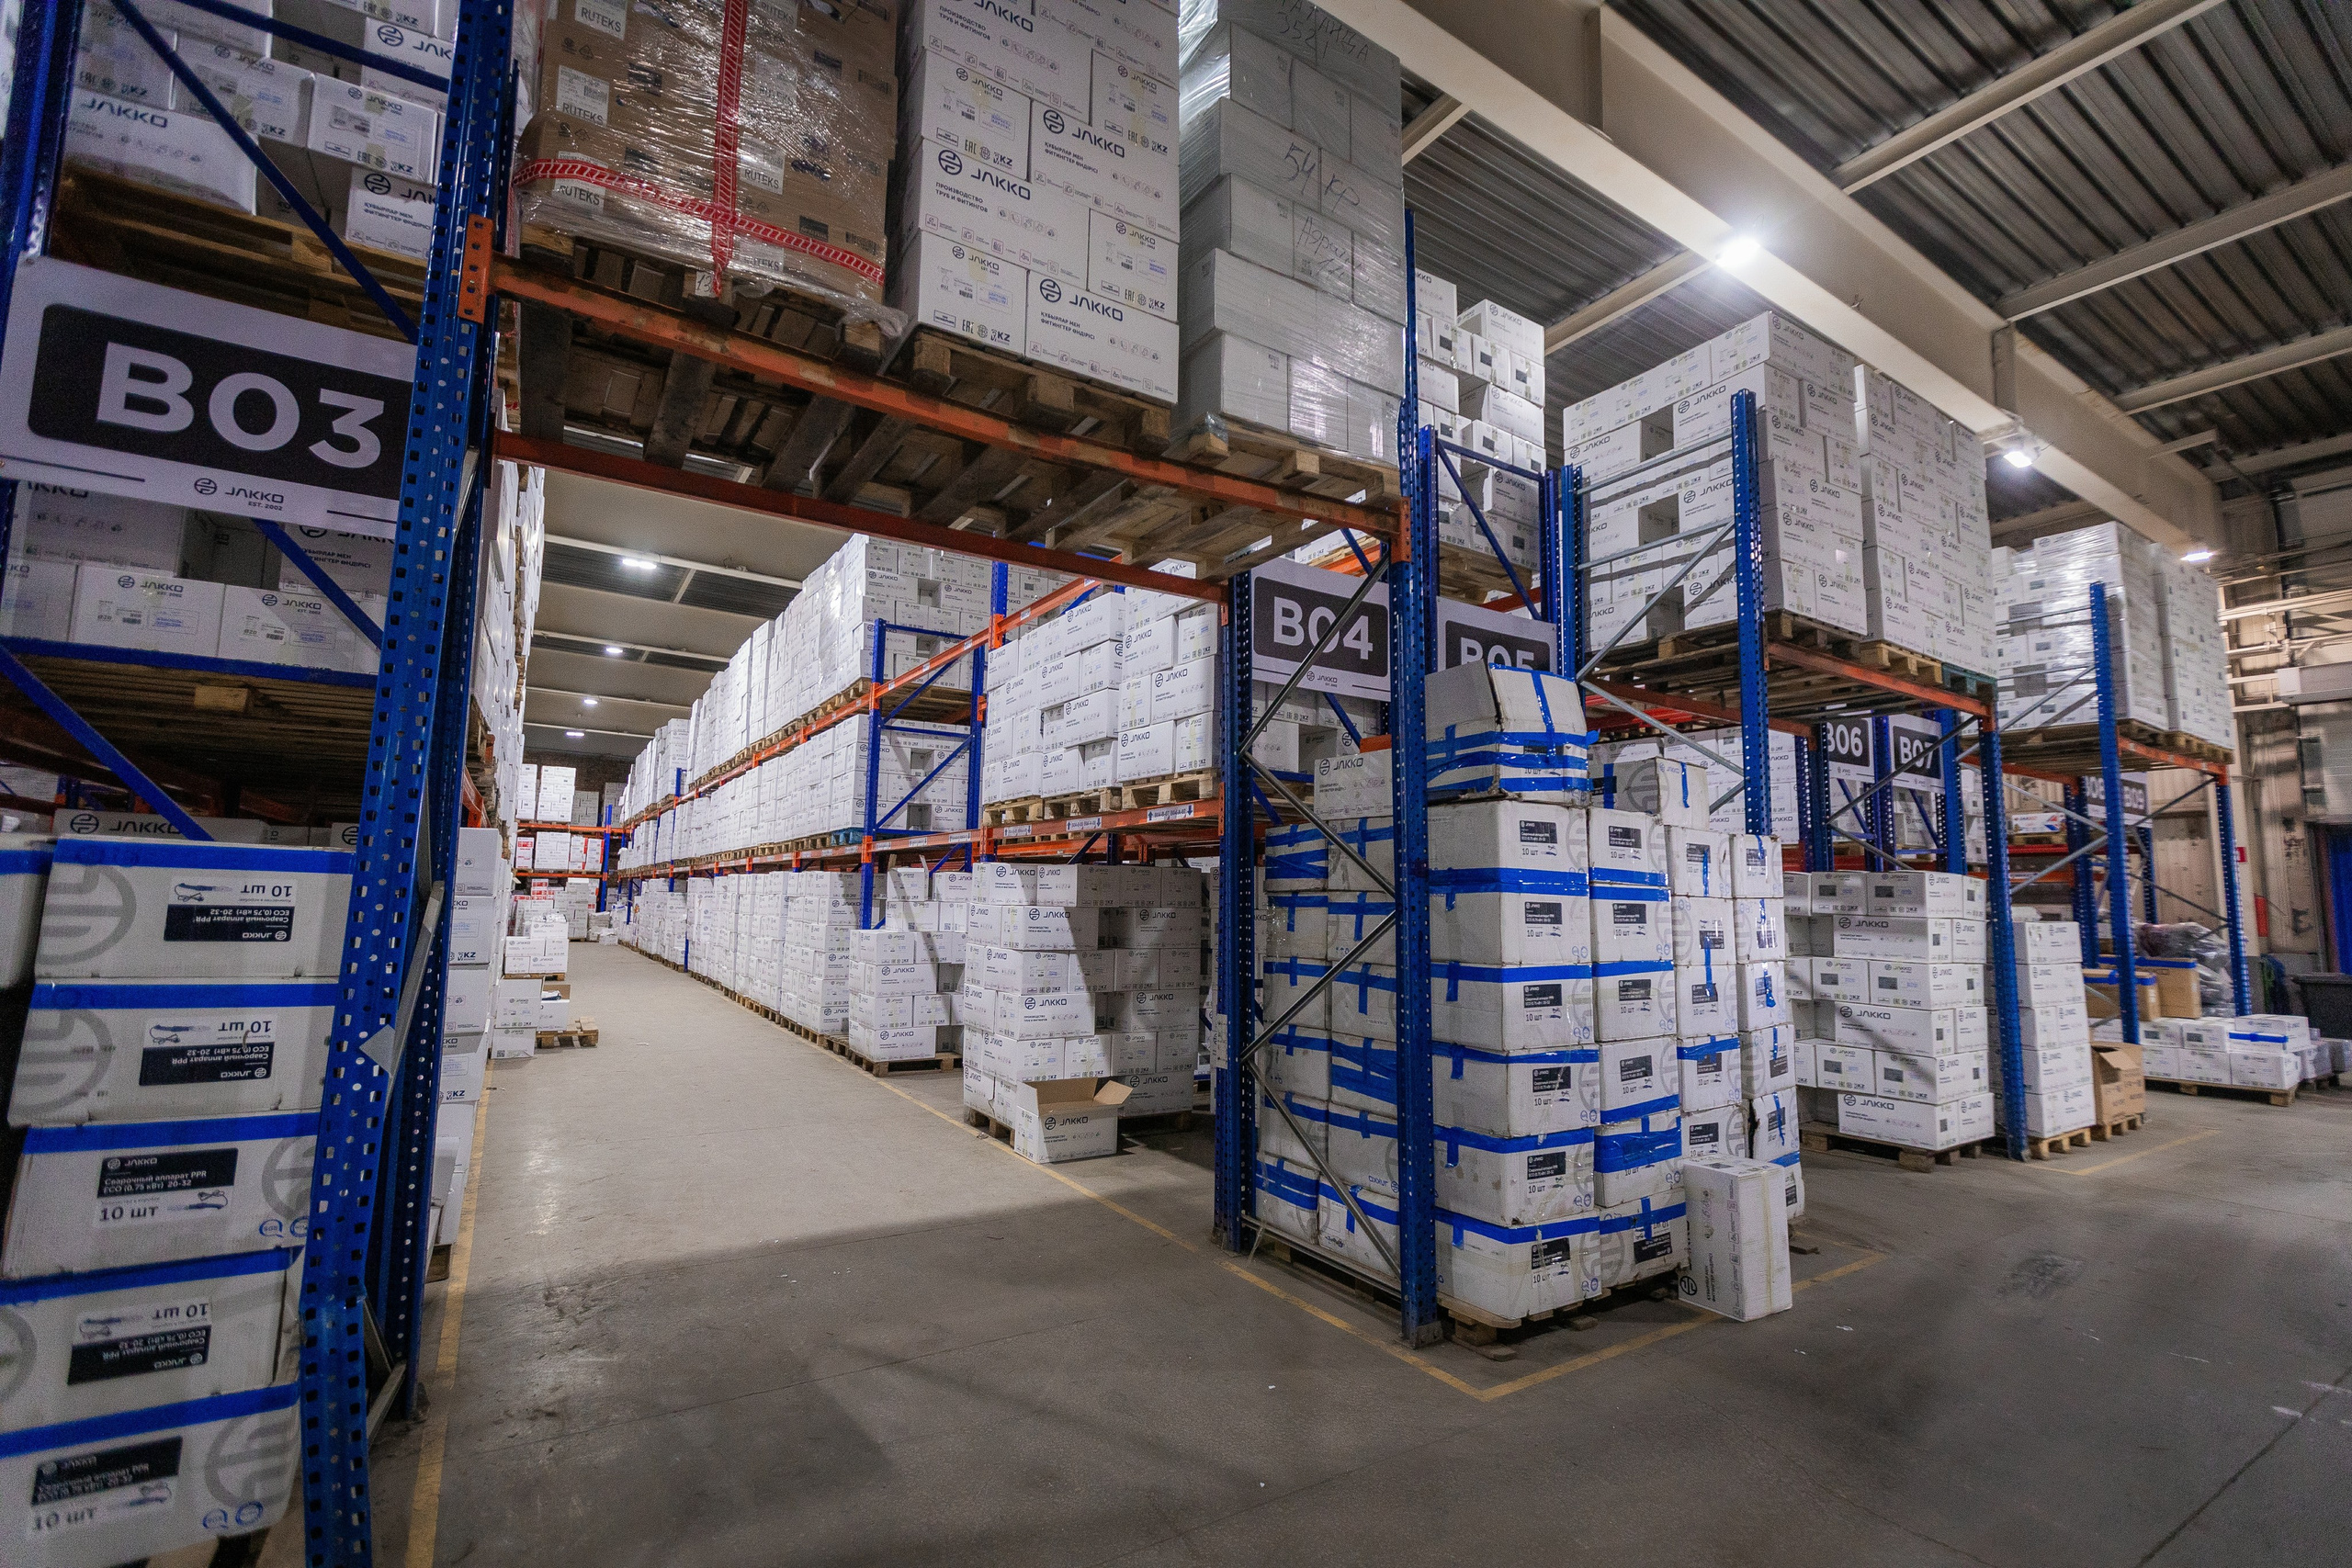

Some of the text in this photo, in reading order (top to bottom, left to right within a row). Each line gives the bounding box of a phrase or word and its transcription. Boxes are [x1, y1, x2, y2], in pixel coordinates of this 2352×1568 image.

[582, 7, 621, 32] RUTEKS
[761, 2, 794, 24] RUTEKS
[939, 6, 986, 30] ПРОИЗВОДСТВО
[974, 0, 1033, 32] JAKKO
[939, 13, 954, 23] ТРУБ
[959, 22, 990, 40] ФИТИНГОВ
[238, 54, 275, 71] JAKKO
[972, 78, 1002, 96] JAKKO
[1132, 74, 1157, 90] JAKKO
[368, 93, 402, 111] JAKKO
[81, 98, 168, 129] JAKKO
[562, 102, 604, 126] RUTEKS
[1072, 128, 1125, 158] JAKKO
[1157, 143, 1168, 153] KZ
[1000, 154, 1012, 166] KZ
[398, 163, 413, 173] KZ
[744, 168, 779, 189] RUTEKS
[970, 168, 1030, 200] JAKKO
[560, 185, 599, 206] RUTEKS
[936, 182, 983, 204] ПРОИЗВОДСТВО
[935, 189, 950, 199] ТРУБ
[956, 197, 988, 213] ФИТИНГОВ
[1129, 231, 1155, 245] JAKKO
[968, 255, 1000, 270] JAKKO
[1069, 294, 1123, 321] JAKKO
[1155, 299, 1165, 310] KZ
[1500, 310, 1522, 326] JAKKO
[1041, 319, 1071, 333] ФИТИНГТЕР
[997, 331, 1010, 342] KZ
[1502, 394, 1523, 409] JAKKO
[1694, 385, 1726, 405] JAKKO
[1583, 435, 1611, 453] JAKKO
[1504, 477, 1526, 491] JAKKO
[224, 487, 285, 504] JAKKO
[248, 501, 283, 512] EST. 2002
[140, 579, 184, 593] JAKKO
[282, 597, 322, 610] JAKKO
[1075, 604, 1091, 617] JAKKO
[1134, 629, 1152, 642] JAKKO
[1049, 662, 1063, 675] JAKKO
[1166, 668, 1188, 682] JAKKO
[1317, 674, 1338, 683] JAKKO
[1073, 699, 1089, 712] JAKKO
[1131, 731, 1150, 743] JAKKO
[1049, 754, 1063, 764] JAKKO
[1334, 758, 1363, 771] JAKKO
[241, 885, 292, 897] 10 шт
[1855, 920, 1889, 929] JAKKO
[1039, 998, 1067, 1007] JAKKO
[1149, 993, 1173, 1001] JAKKO
[1857, 1010, 1891, 1020] JAKKO
[219, 1021, 272, 1033] 10 шт
[1143, 1076, 1169, 1085] JAKKO
[1534, 1098, 1542, 1106] 10
[1860, 1100, 1894, 1111] JAKKO
[1059, 1116, 1089, 1126] JAKKO
[125, 1158, 157, 1167] JAKKO
[1529, 1185, 1536, 1193] 10
[99, 1206, 158, 1221] 10 шт
[1532, 1275, 1541, 1284] 10
[187, 1303, 209, 1317] 10
